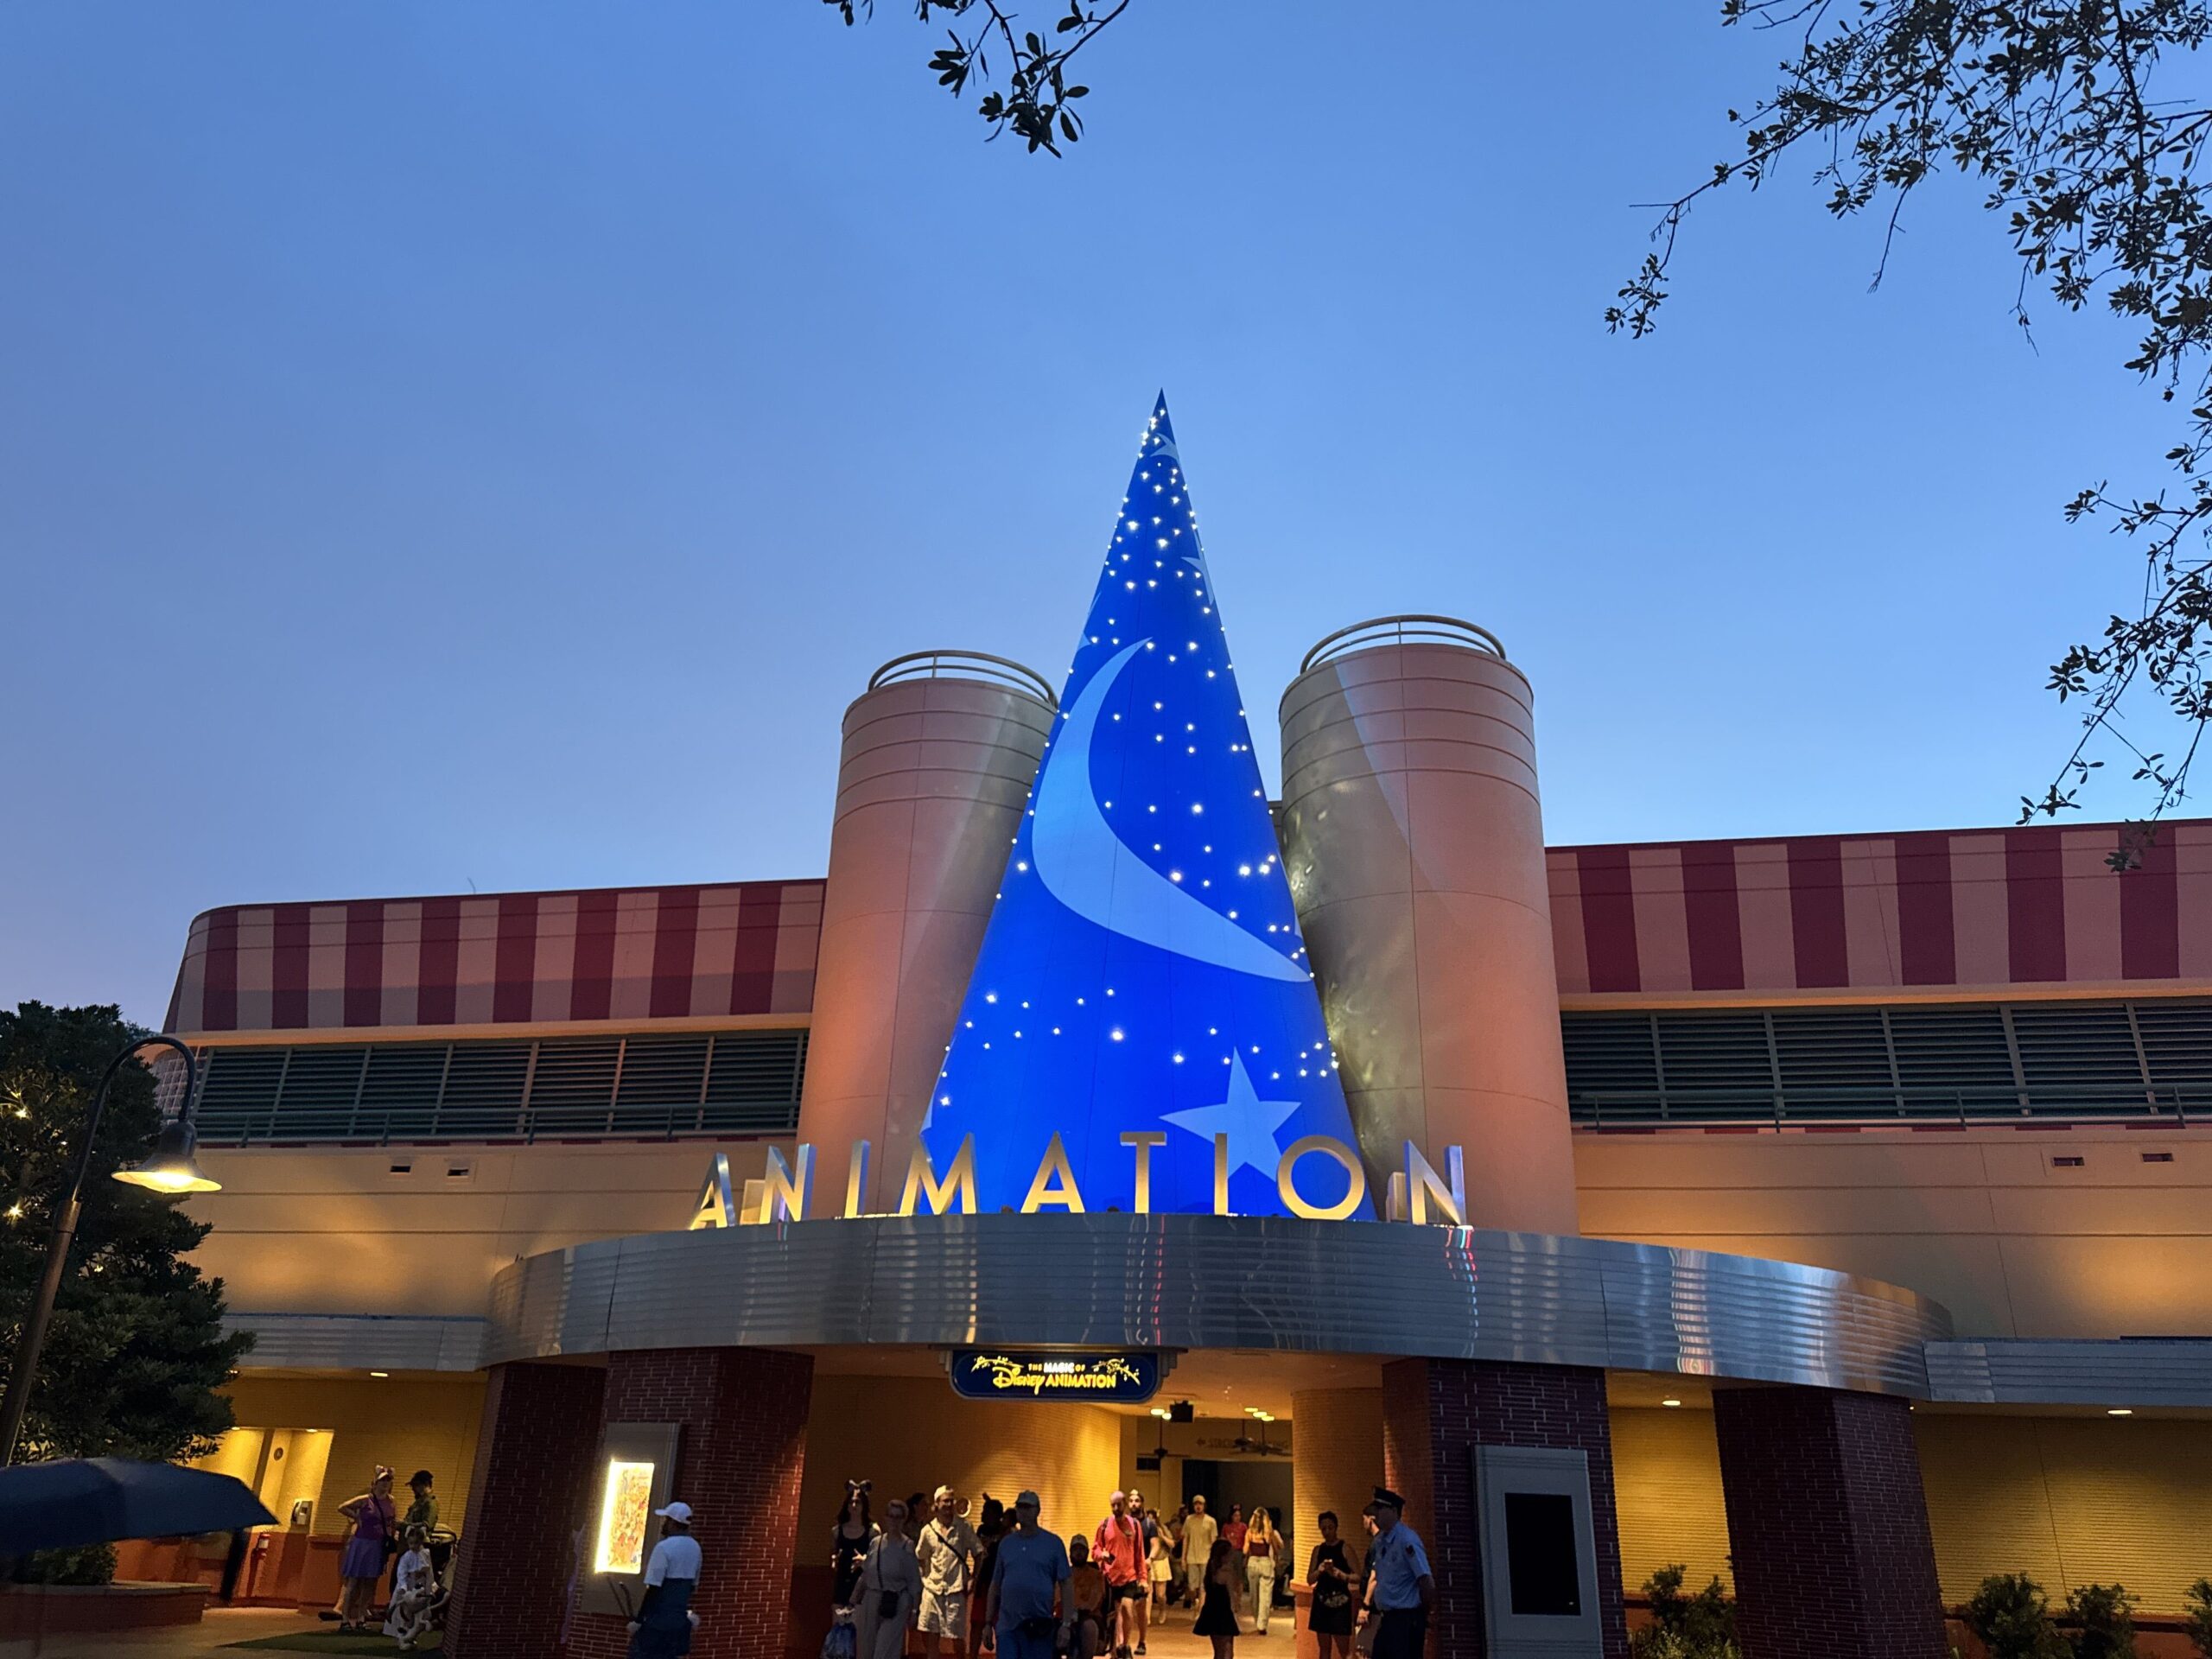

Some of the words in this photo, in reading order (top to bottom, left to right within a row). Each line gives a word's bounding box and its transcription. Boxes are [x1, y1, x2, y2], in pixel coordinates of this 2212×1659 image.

[689, 1131, 1466, 1230] ANIMATION
[1043, 1362, 1075, 1373] MAGIC
[1075, 1363, 1086, 1372] OF
[1045, 1374, 1116, 1389] ANIMATION
